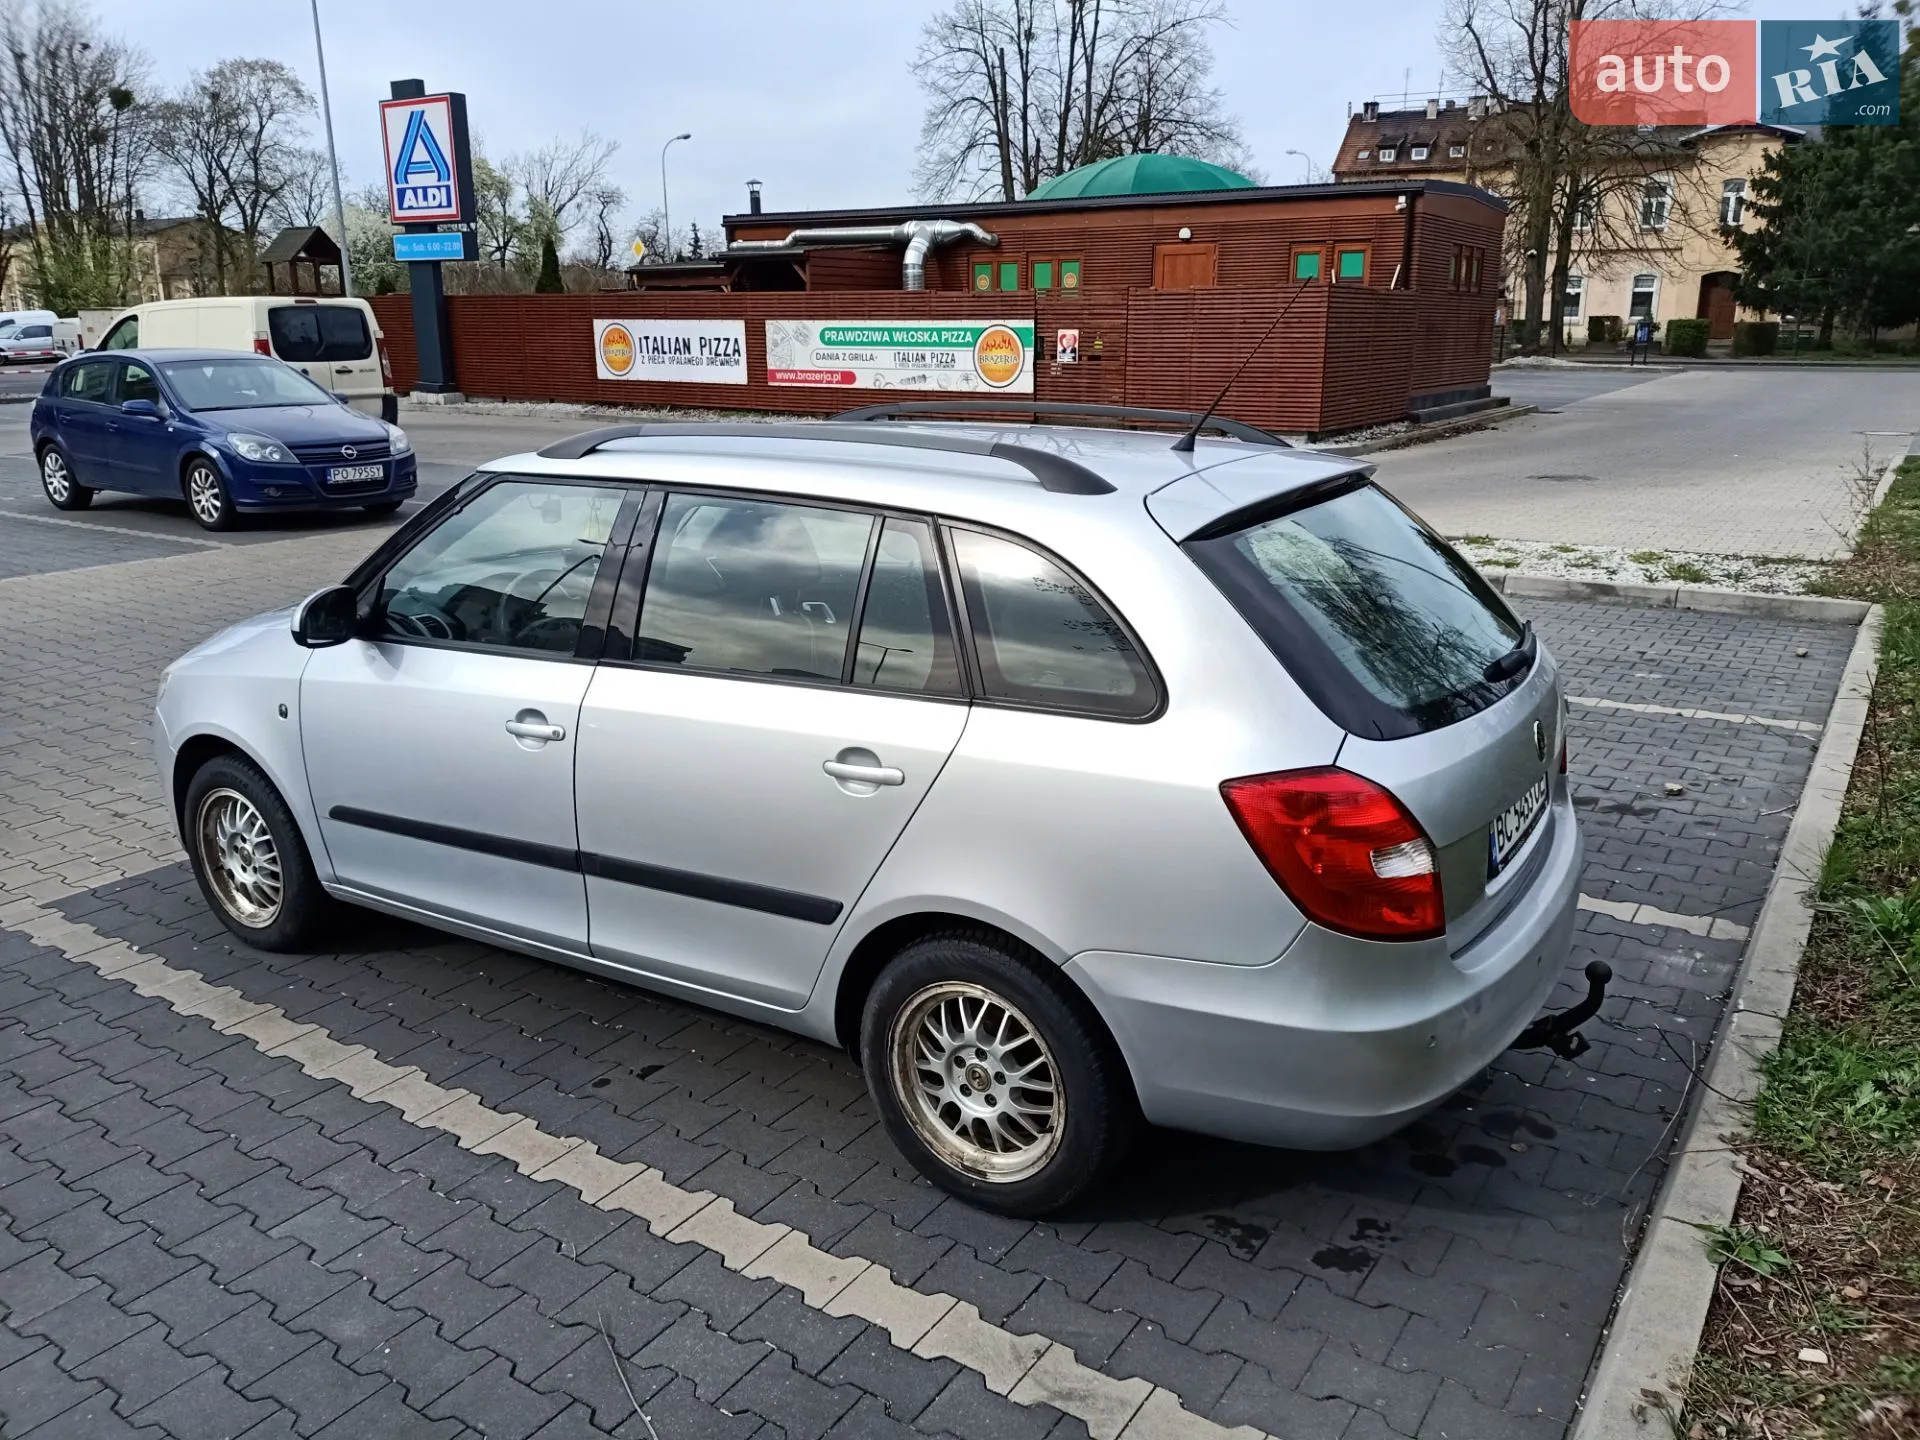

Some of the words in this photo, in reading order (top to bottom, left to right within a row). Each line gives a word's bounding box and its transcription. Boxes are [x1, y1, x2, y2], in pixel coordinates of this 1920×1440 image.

[402, 187, 448, 209] ALDI
[824, 331, 890, 343] PRAWDZIWA
[892, 331, 938, 343] WŁOSKA
[941, 331, 973, 343] PIZZA
[638, 336, 691, 355] ITALIAN
[699, 336, 742, 358] PIZZA
[641, 356, 646, 365] Z
[647, 356, 666, 366] PIECA
[668, 356, 704, 367] OPALANEGO
[706, 357, 740, 367] DREWNEM
[815, 352, 840, 361] DANIA
[842, 353, 848, 362] Z
[893, 351, 927, 363] ITALIAN
[930, 352, 956, 364] PIZZA
[333, 468, 349, 480] PO
